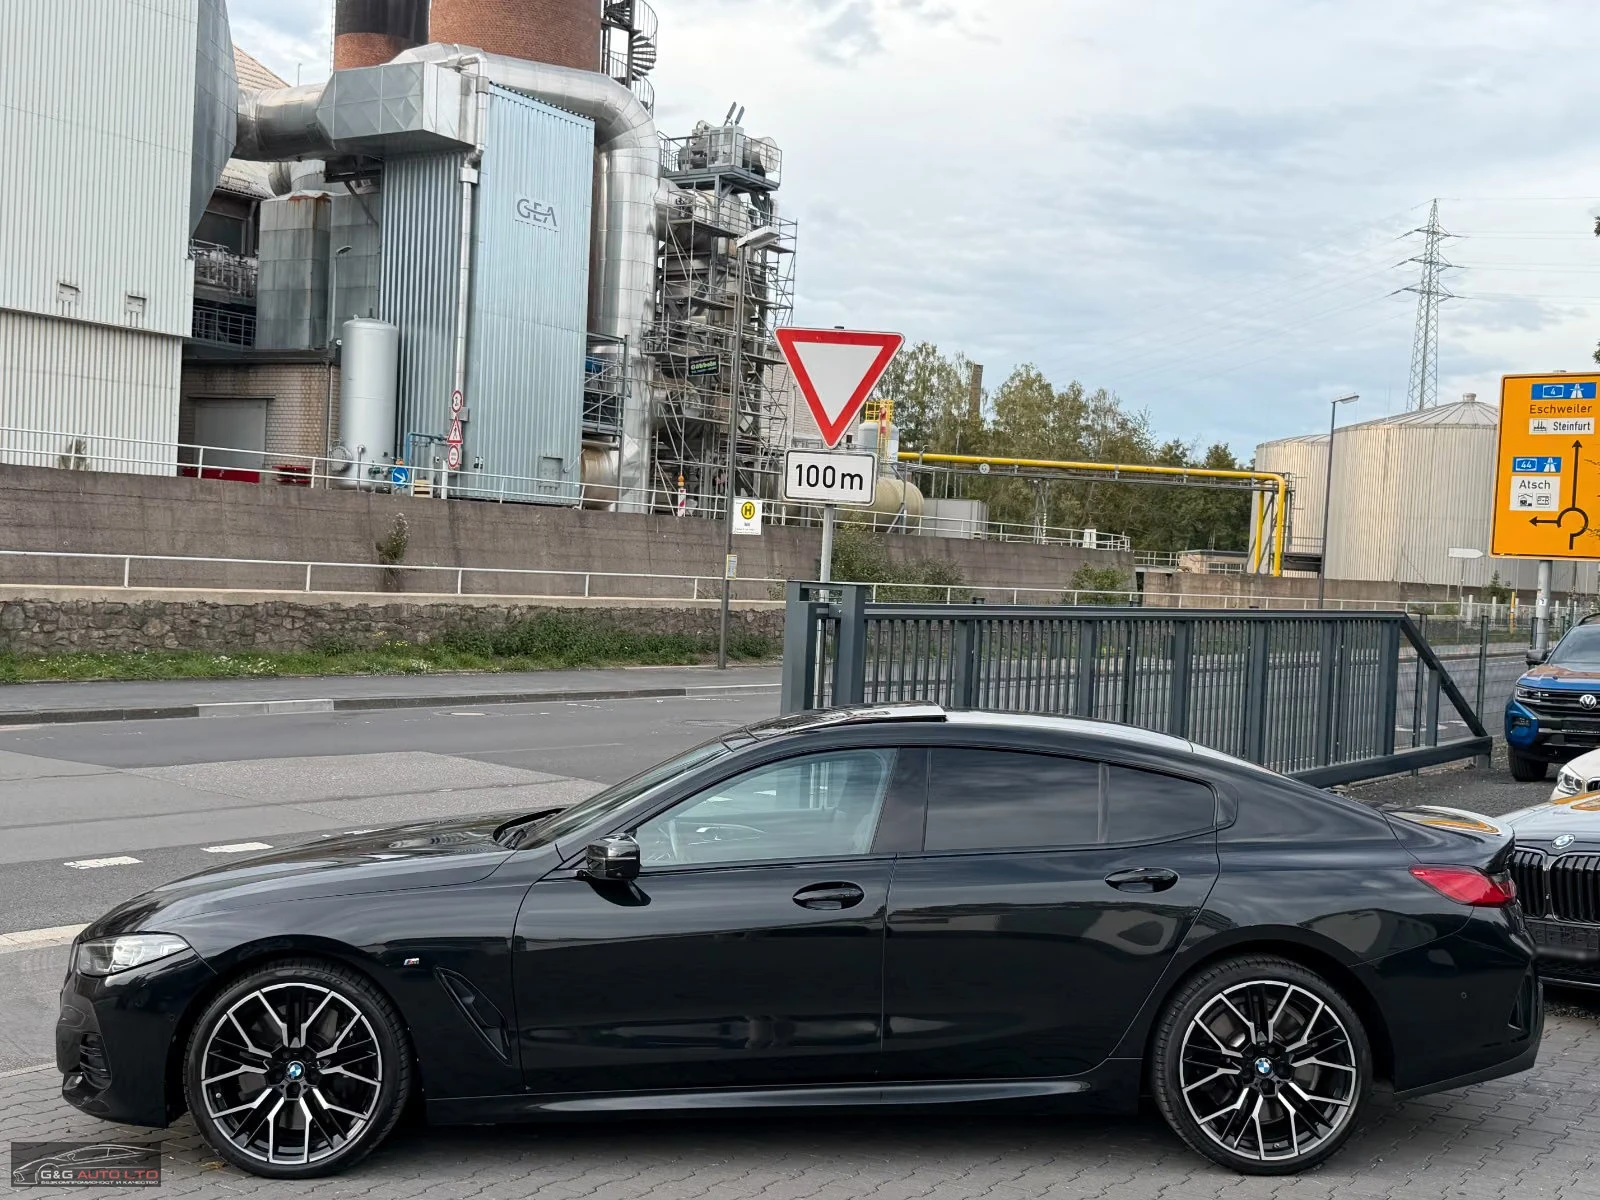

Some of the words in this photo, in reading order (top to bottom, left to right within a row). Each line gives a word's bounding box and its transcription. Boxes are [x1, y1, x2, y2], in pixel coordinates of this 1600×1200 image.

[516, 198, 557, 227] GEA
[1529, 403, 1593, 414] Eschweiler
[1553, 421, 1591, 431] Steinfurt
[1520, 460, 1532, 469] 44
[1519, 480, 1551, 490] Atsch
[744, 505, 752, 516] H
